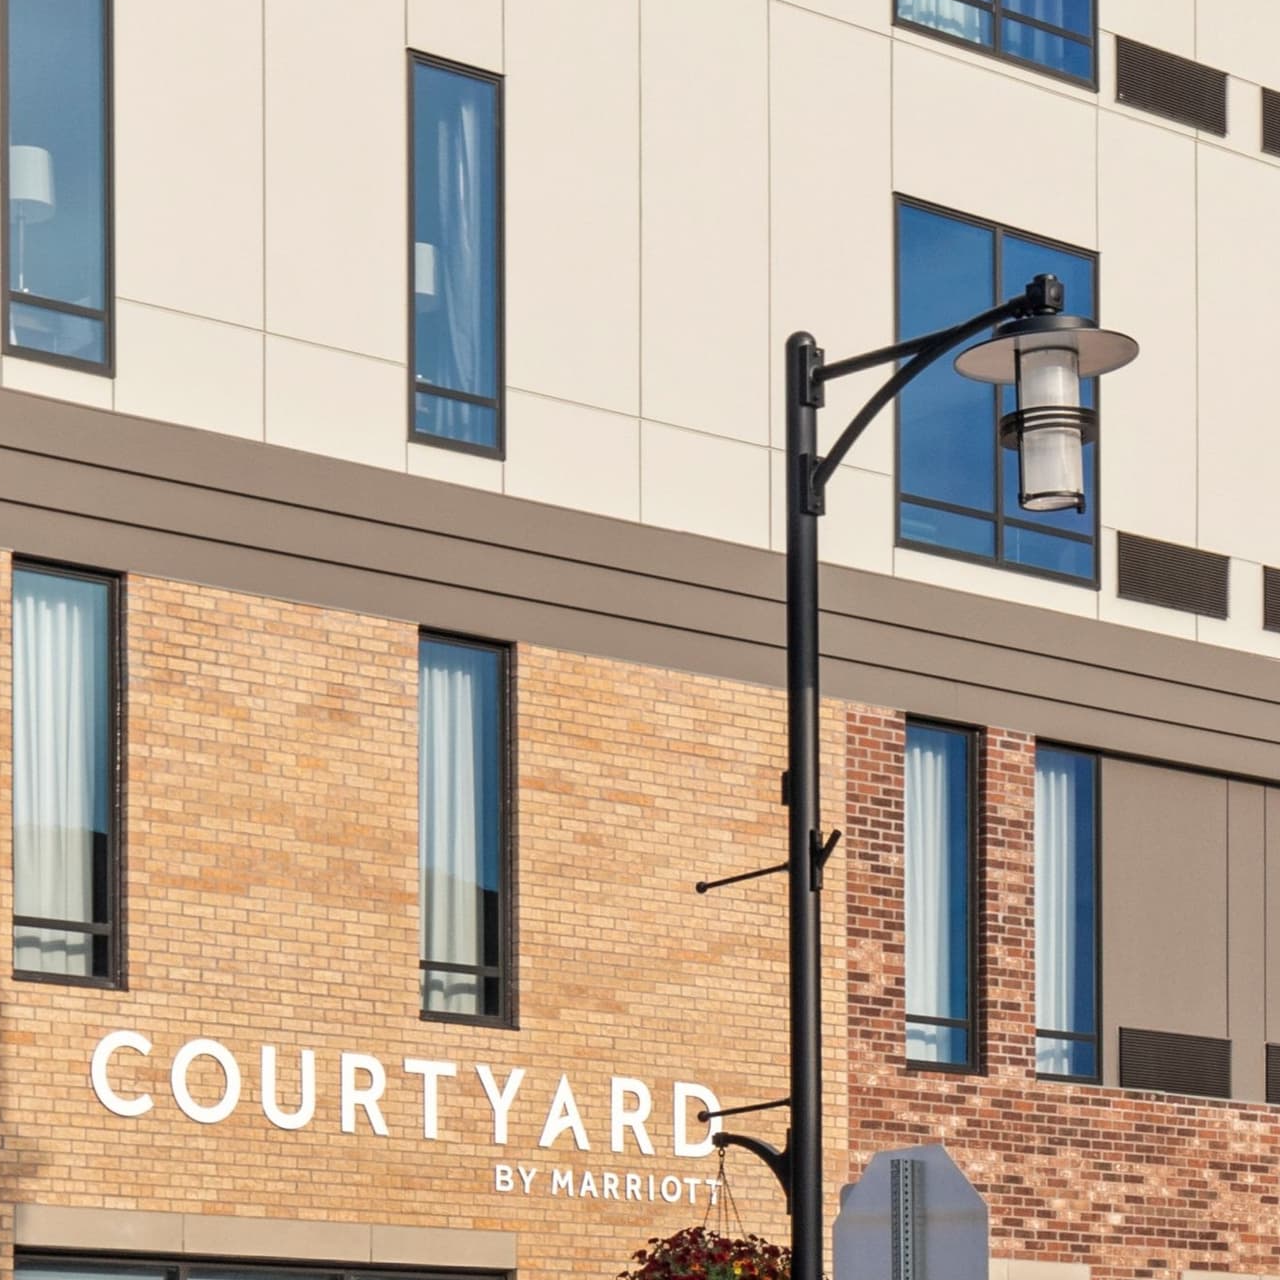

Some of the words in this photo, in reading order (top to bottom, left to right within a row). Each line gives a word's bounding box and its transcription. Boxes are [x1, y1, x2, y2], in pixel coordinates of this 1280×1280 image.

[90, 1029, 723, 1158] COURTYARD
[495, 1164, 537, 1195] BY
[551, 1168, 723, 1206] MARRIOTT
